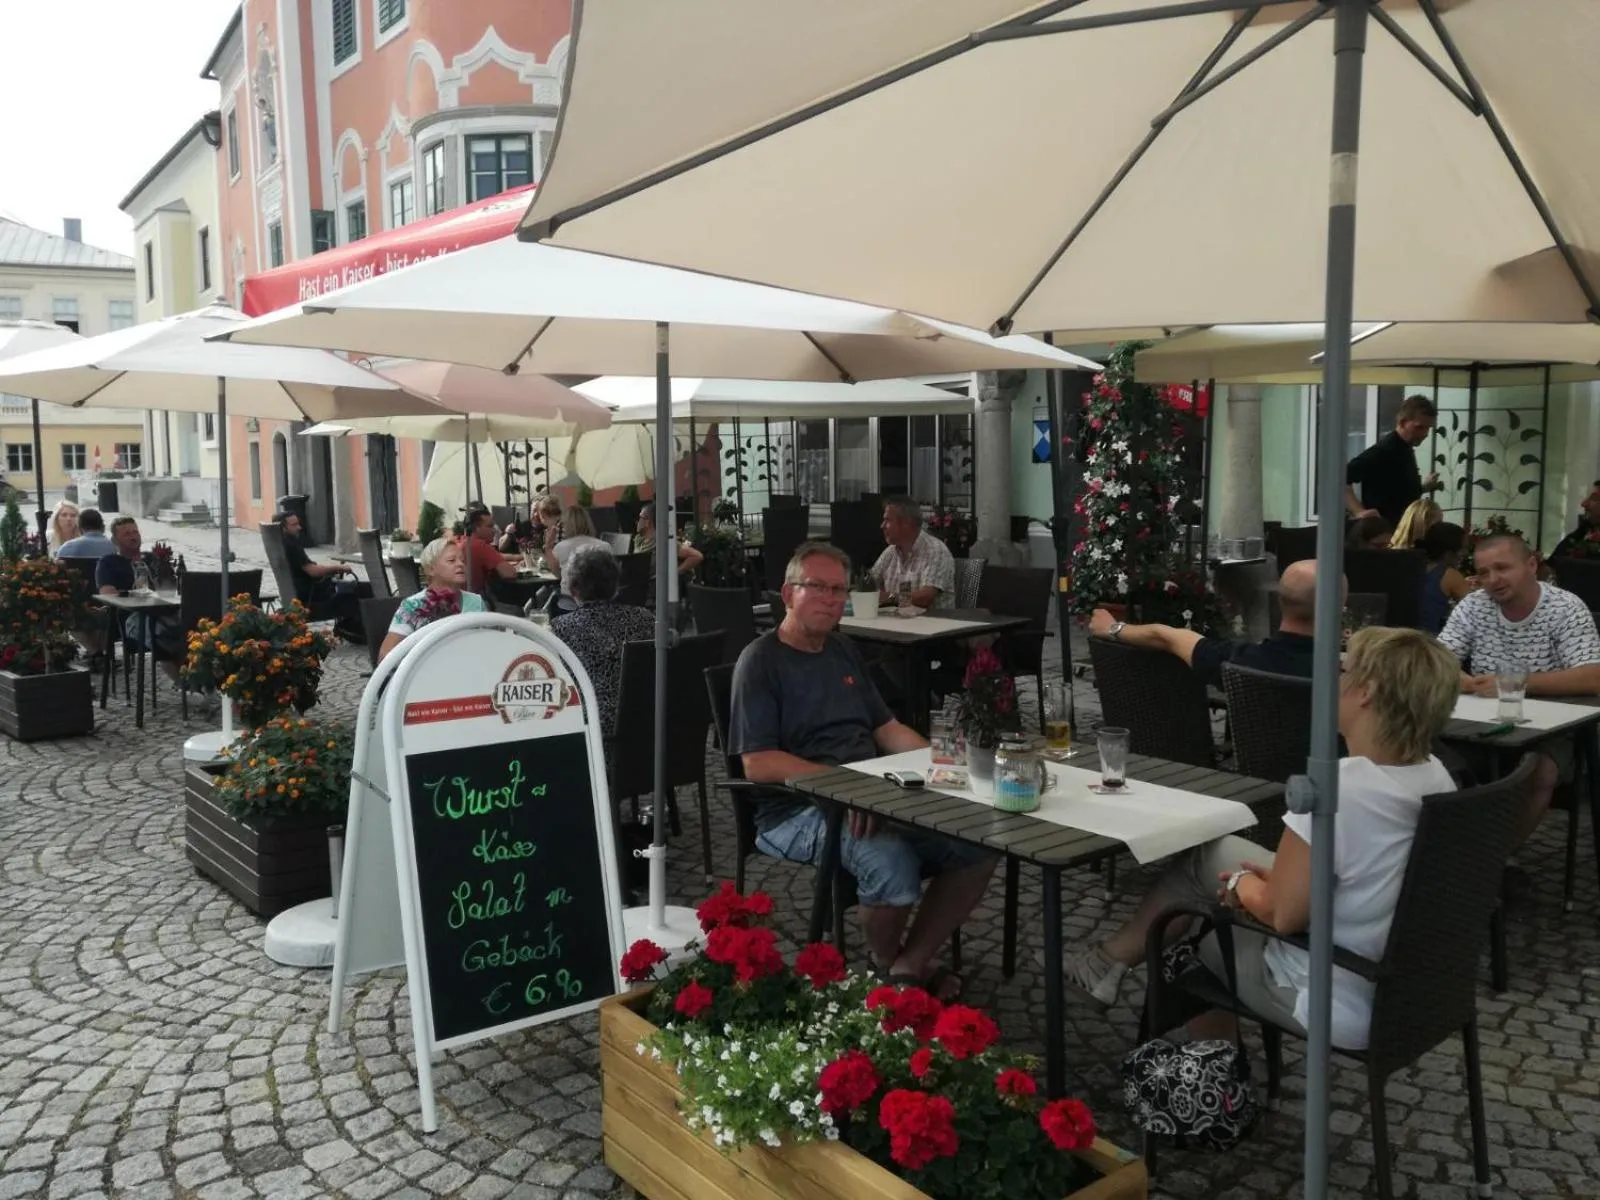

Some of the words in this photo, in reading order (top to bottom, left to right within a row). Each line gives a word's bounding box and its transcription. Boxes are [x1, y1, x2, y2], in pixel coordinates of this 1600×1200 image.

[299, 275, 321, 300] Hast
[323, 269, 338, 292] ein
[342, 261, 375, 288] Kaiser
[502, 683, 553, 702] KAISER
[424, 760, 526, 819] Wurst
[472, 829, 537, 863] Käse
[448, 872, 526, 928] Salat
[481, 982, 512, 1014] €
